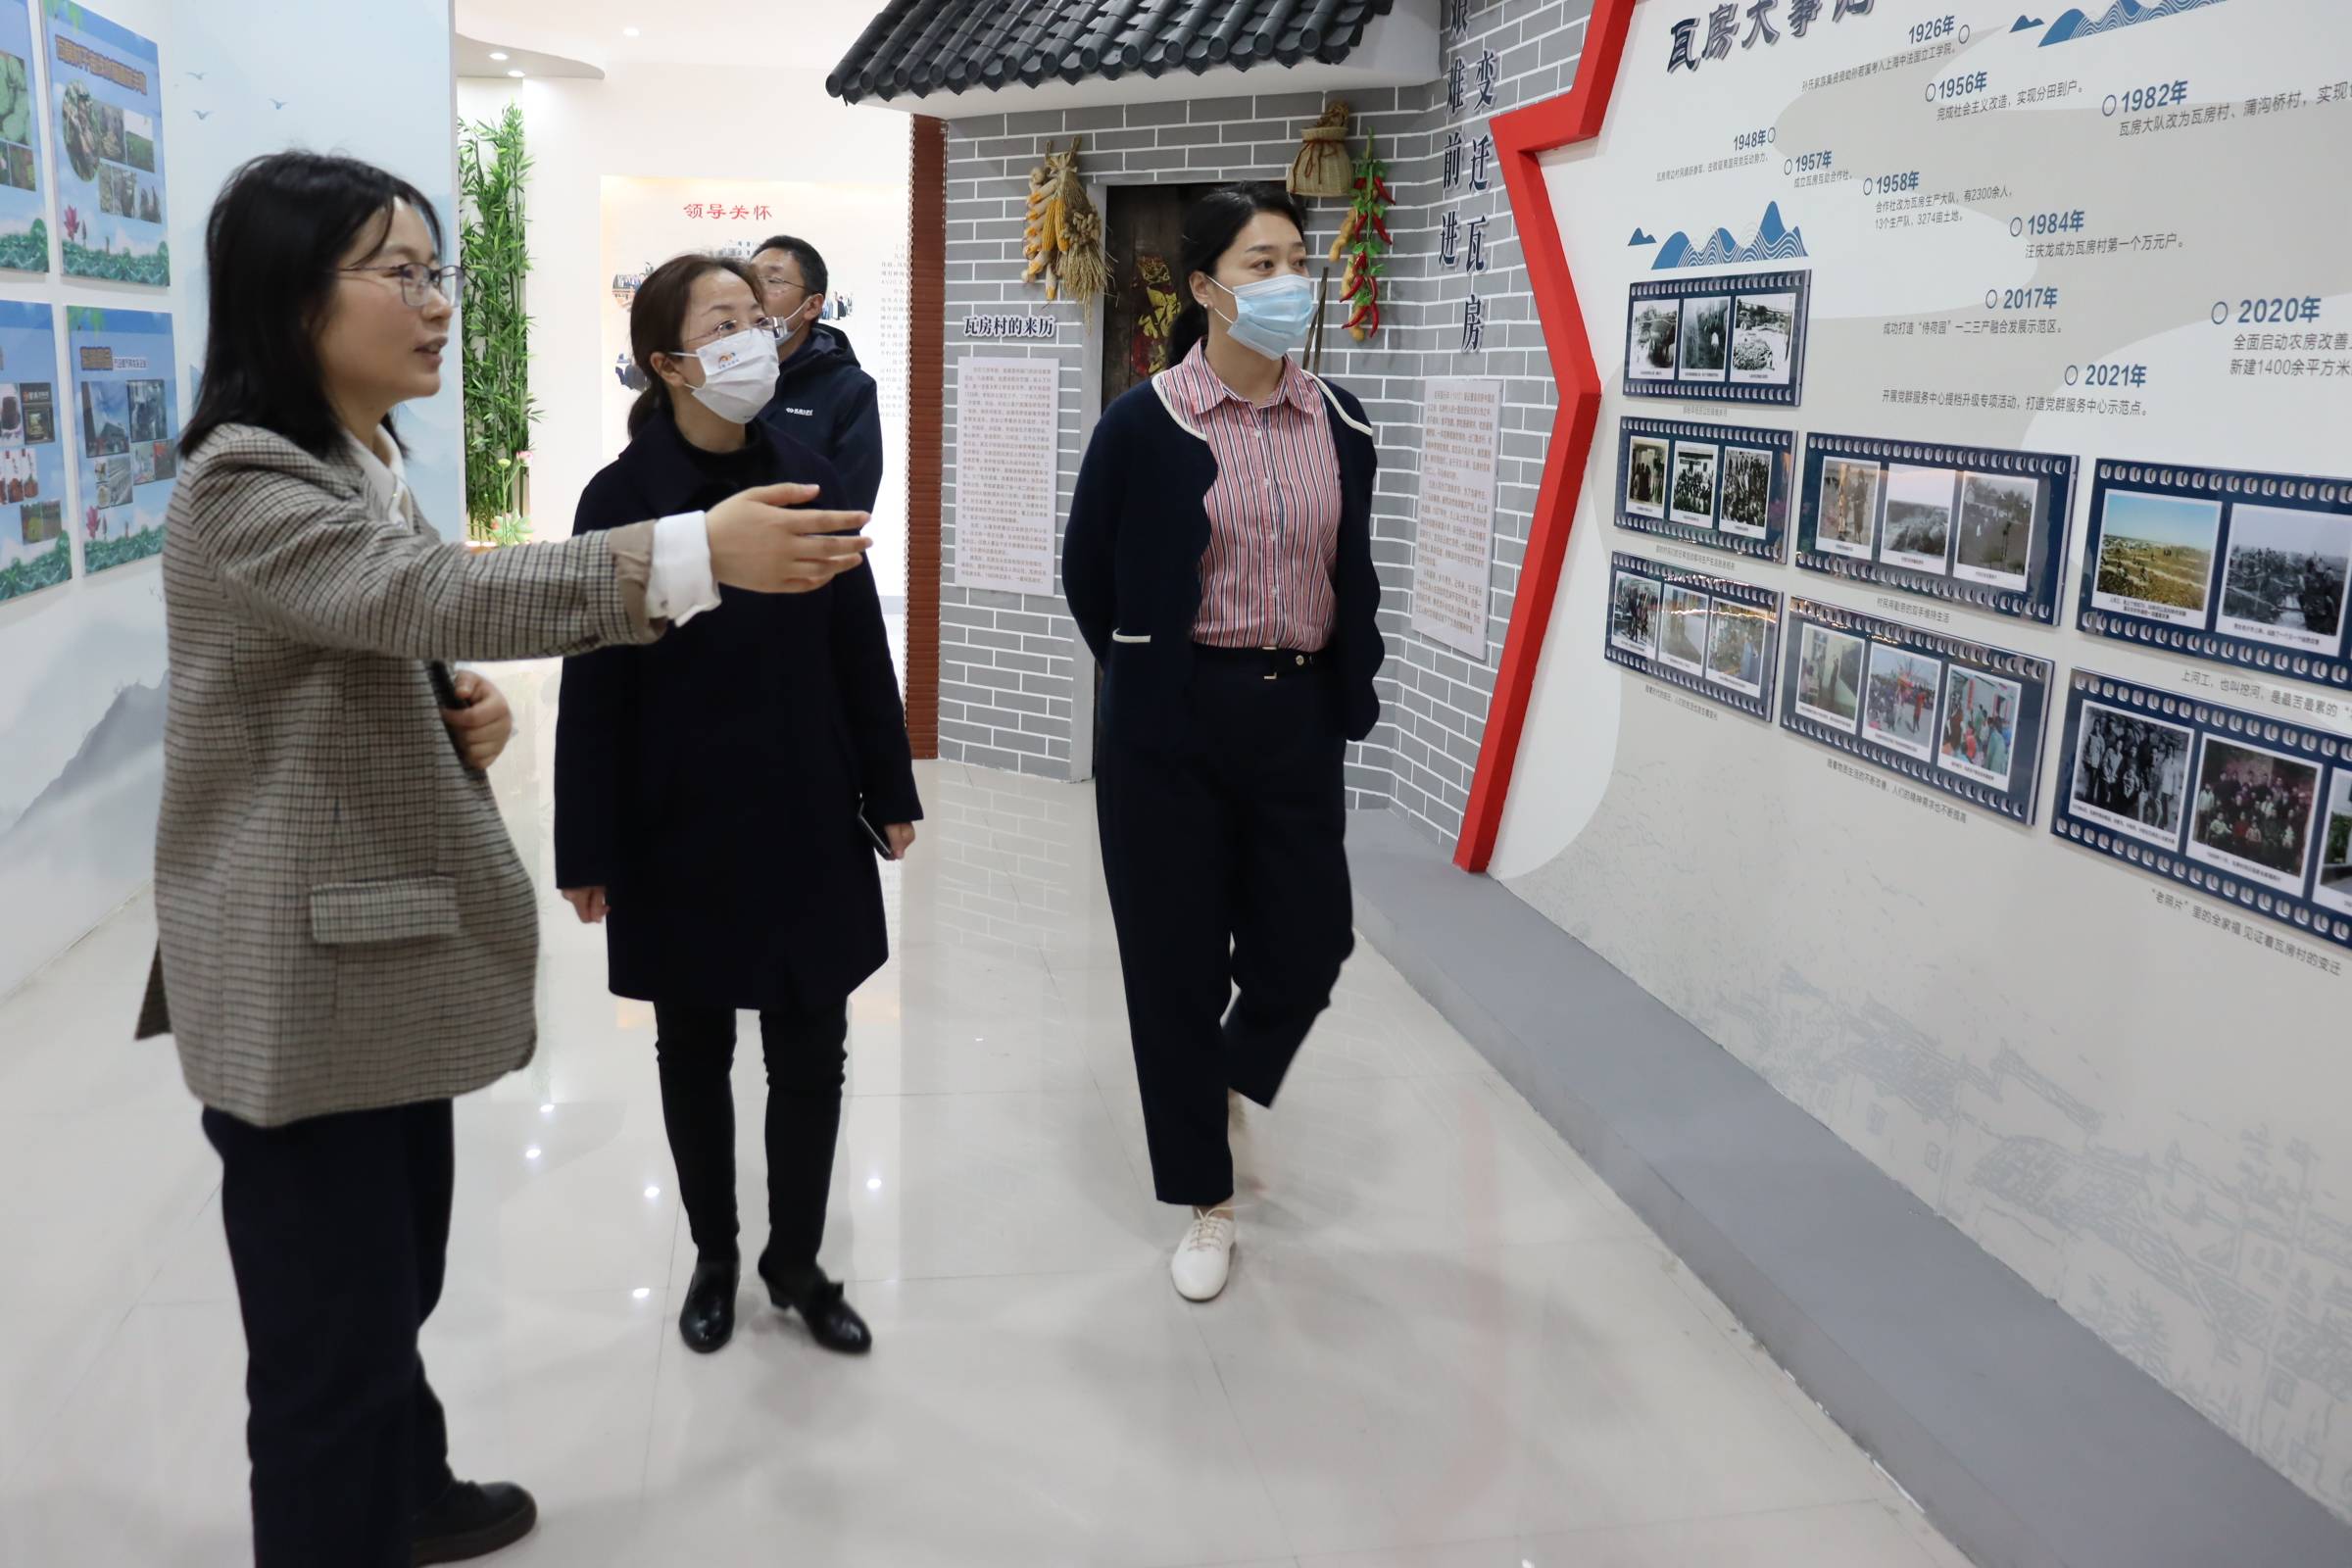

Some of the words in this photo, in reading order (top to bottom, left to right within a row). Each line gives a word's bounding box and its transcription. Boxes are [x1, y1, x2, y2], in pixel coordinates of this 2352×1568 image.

[1908, 15, 1955, 44] 1926年
[1937, 71, 1987, 99] 1956年
[2121, 79, 2188, 113] 1982年
[1936, 79, 2083, 121] 完成社会主义改造，实现分田到户。
[2119, 81, 2352, 137] 瓦房大队改为瓦房村、蒲沟桥村，实现
[1733, 129, 1766, 151] 1948年
[1794, 149, 1833, 172] 1957年
[1876, 170, 1919, 194] 1958年
[683, 203, 772, 220] 领导关怀
[1462, 49, 1496, 352] 变迁瓦房
[2028, 210, 2084, 235] 1984年
[2003, 286, 2058, 309] 2017年
[2237, 296, 2321, 322] 2020年
[963, 316, 1054, 336] 瓦房村的来历
[2233, 333, 2352, 351] 全面启动农房改善
[2084, 364, 2147, 387] 2021年
